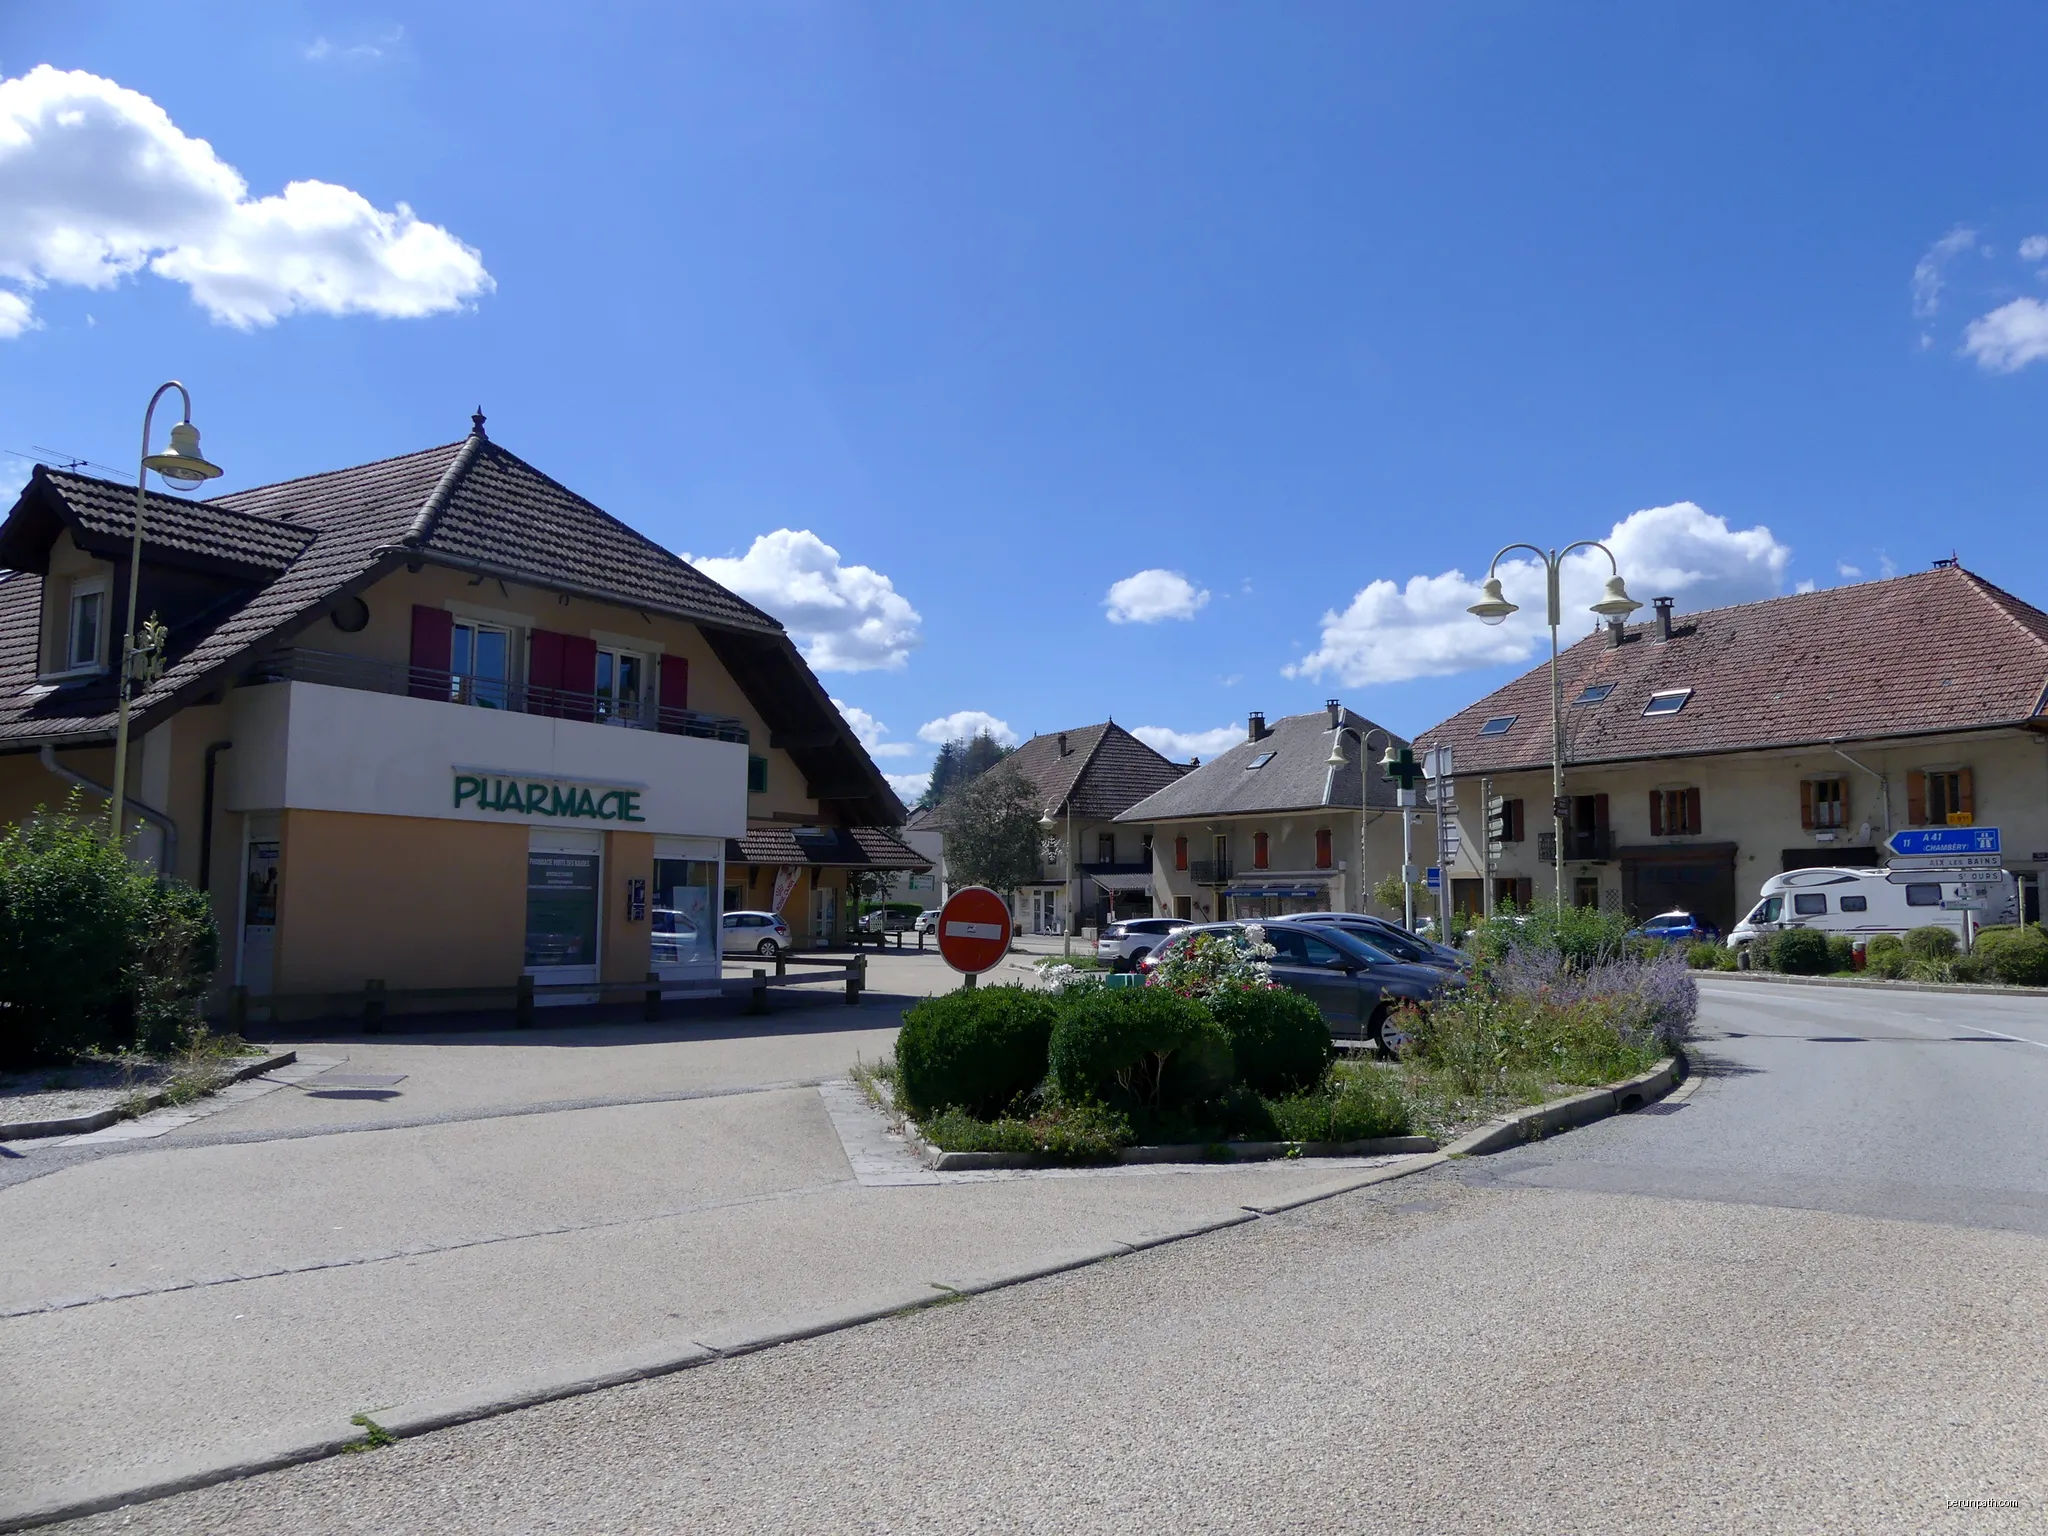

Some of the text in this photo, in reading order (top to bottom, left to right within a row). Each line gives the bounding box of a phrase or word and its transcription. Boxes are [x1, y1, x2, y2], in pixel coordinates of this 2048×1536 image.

[454, 776, 646, 822] PHARMACIE
[1922, 832, 1942, 842] A 41
[1903, 839, 1911, 848] 11
[1929, 859, 1945, 867] AIX
[1967, 857, 1998, 865] BAINS
[1972, 872, 1998, 880] OURS
